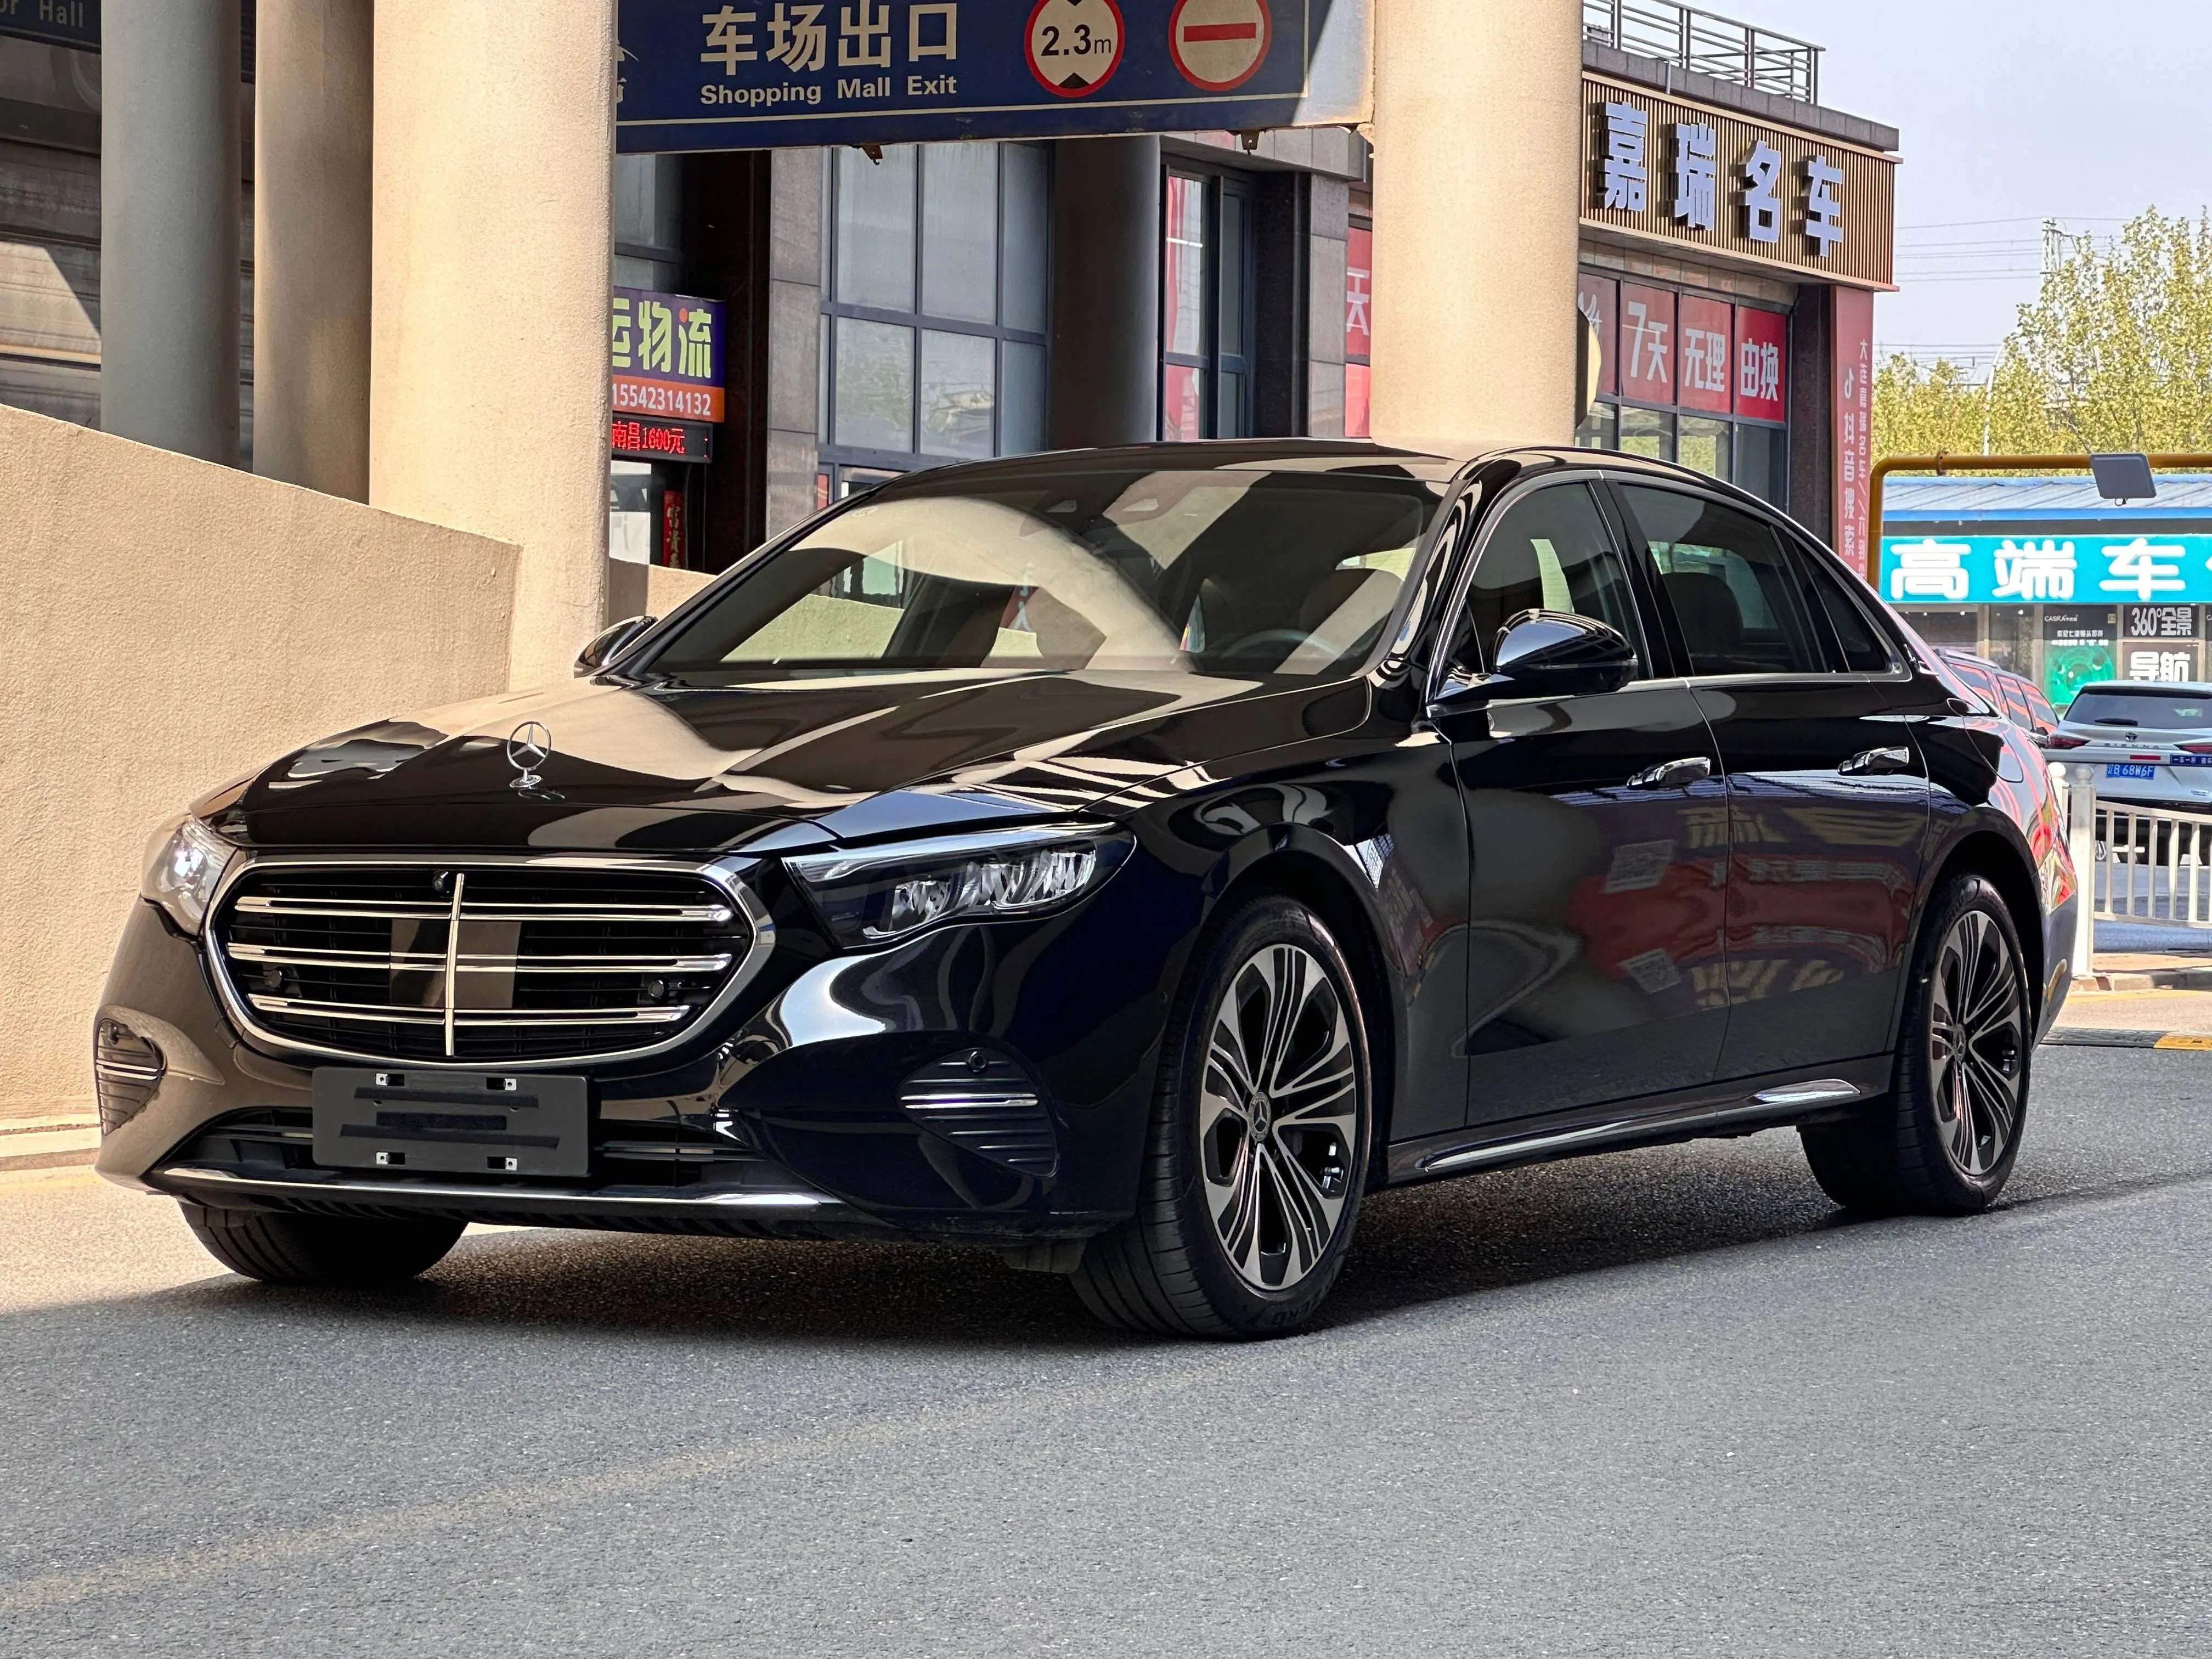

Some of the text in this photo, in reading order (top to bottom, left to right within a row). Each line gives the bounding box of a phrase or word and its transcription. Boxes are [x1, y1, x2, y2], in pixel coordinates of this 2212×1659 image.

[38, 0, 83, 28] Hall
[701, 0, 957, 76] 车场出口
[701, 75, 957, 107] Shopping Mall Exit
[1604, 101, 1843, 258] 嘉瑞名车
[613, 383, 712, 416] 15542314132
[1844, 412, 1854, 557] 抖音搜索
[1890, 537, 2212, 602] 高端车
[2130, 651, 2191, 682] 导航
